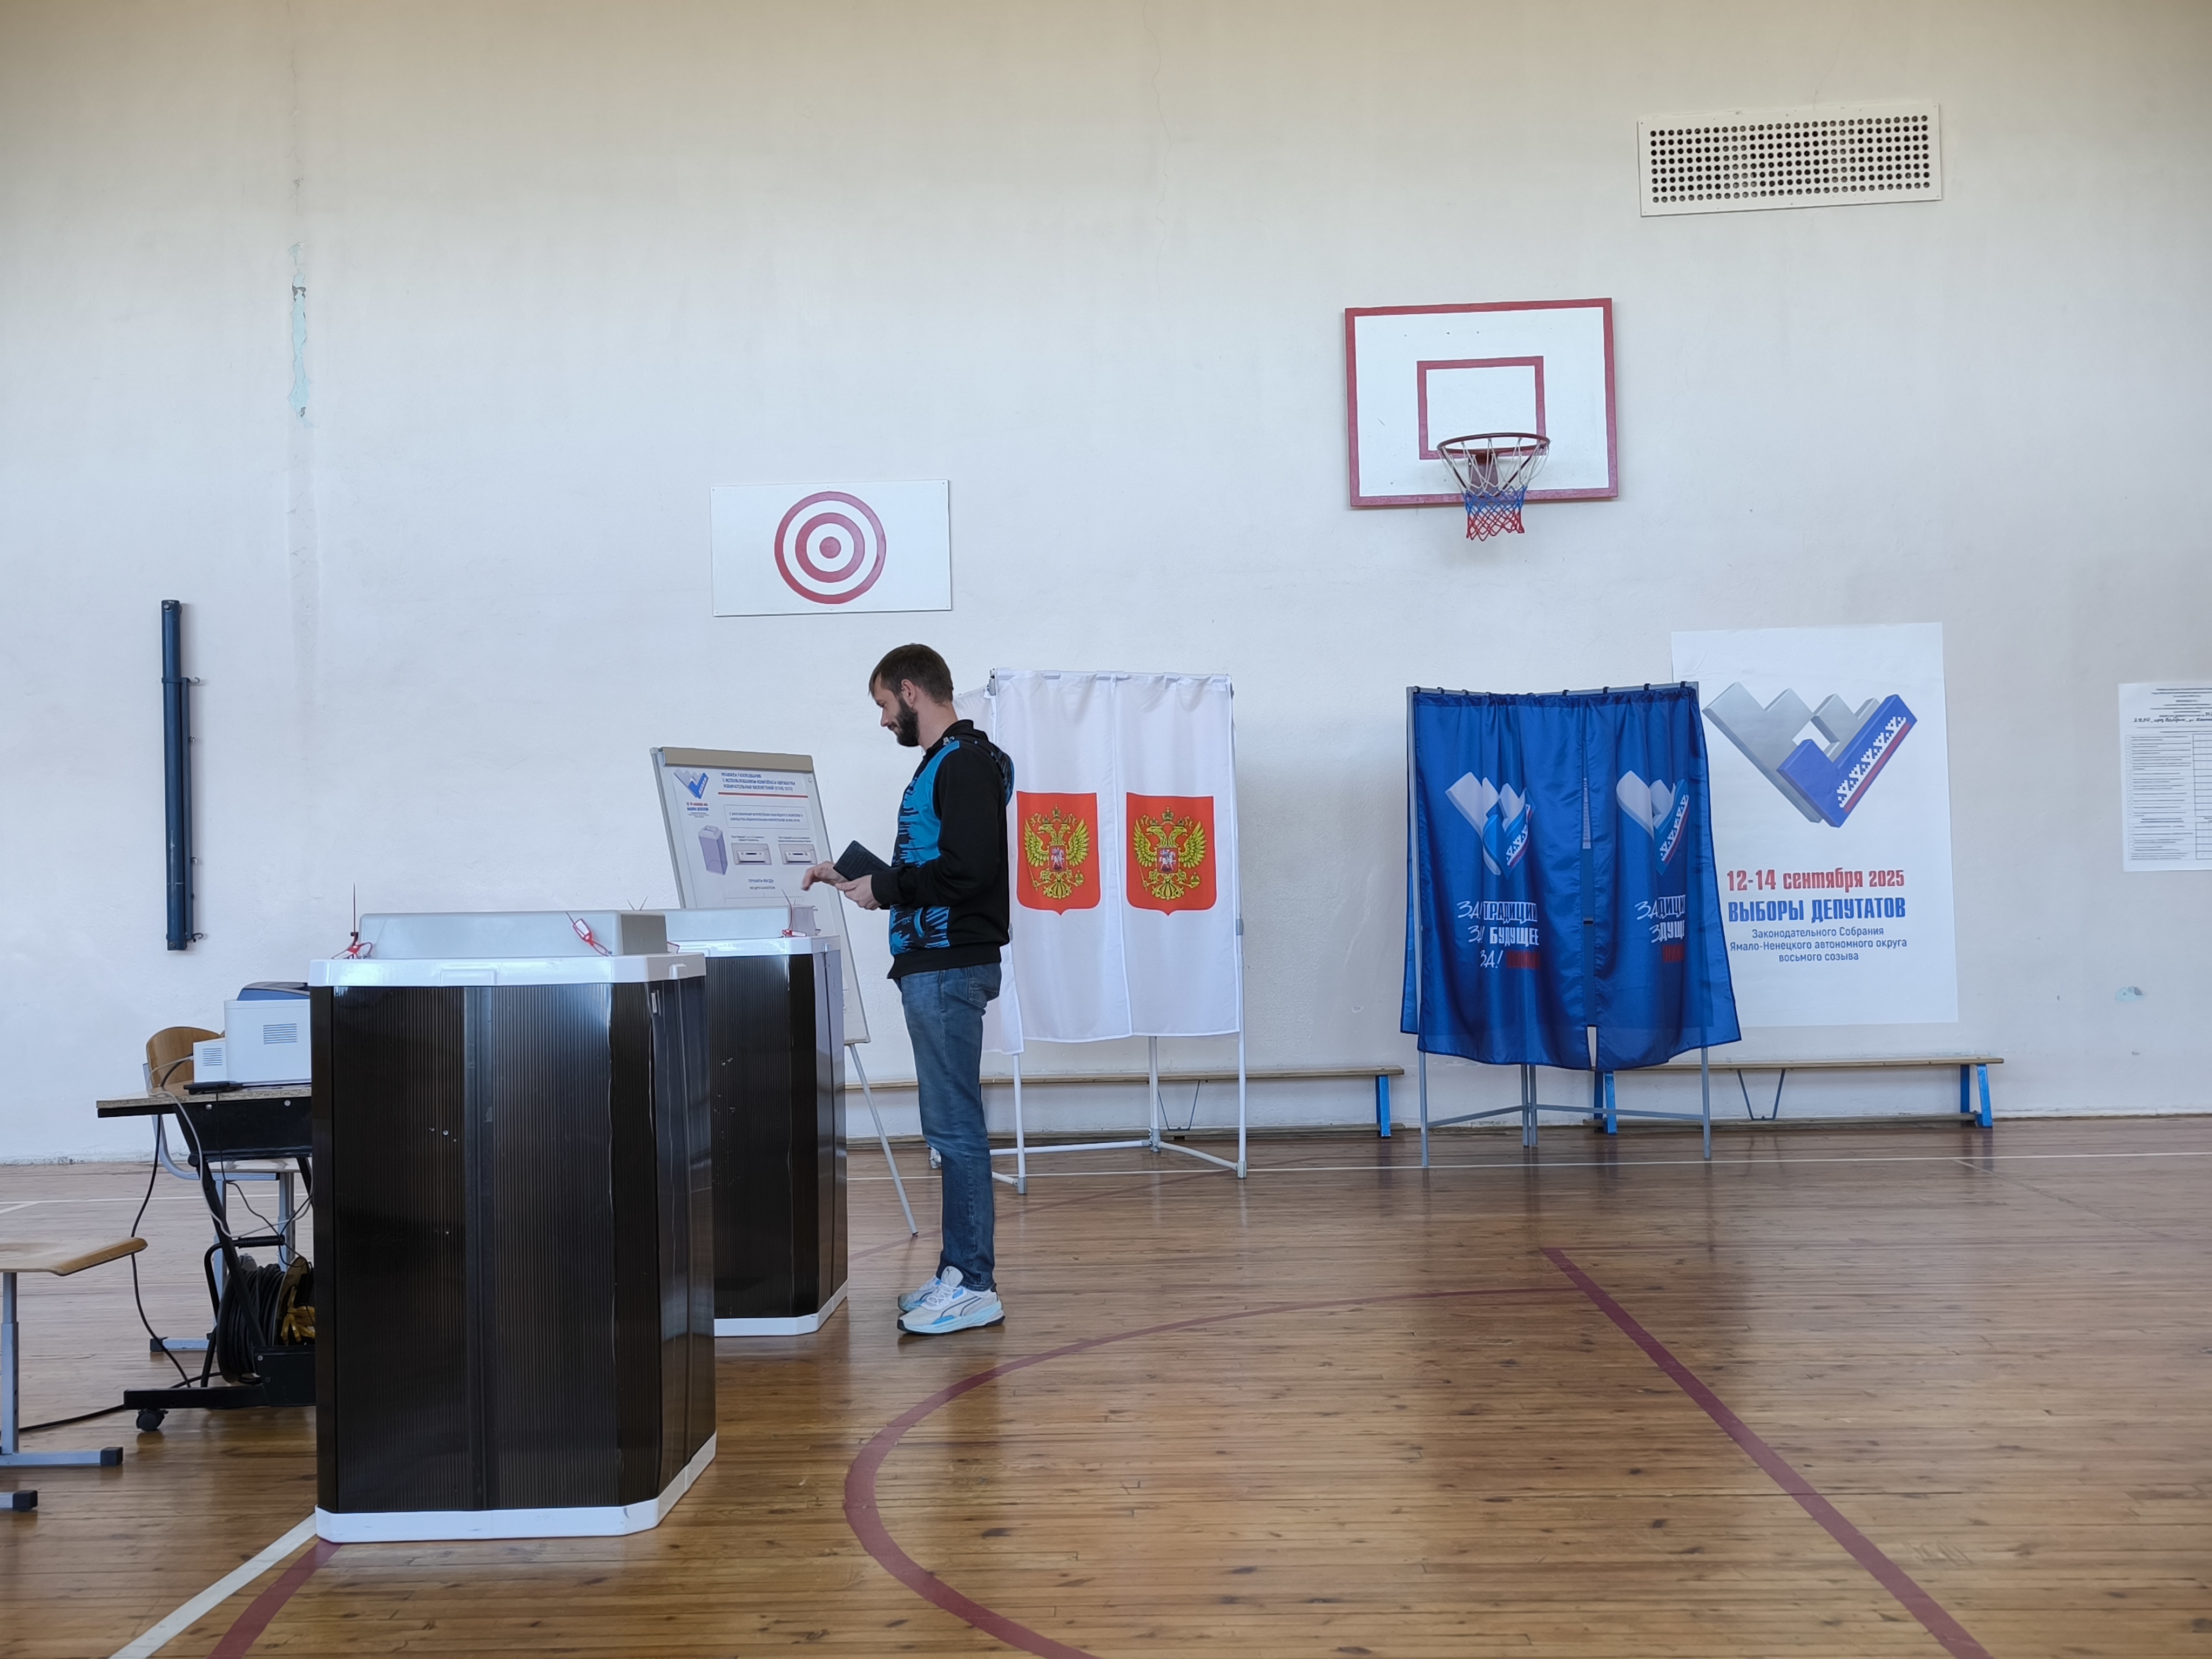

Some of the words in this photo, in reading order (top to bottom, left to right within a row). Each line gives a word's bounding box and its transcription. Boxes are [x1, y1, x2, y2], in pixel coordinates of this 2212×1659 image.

[1727, 869, 1776, 891] 12-14
[1783, 867, 1863, 893] сентября
[1869, 869, 1905, 887] 2025
[1728, 900, 1804, 922] ВЫБОРЫ
[1811, 897, 1905, 923] ДЕПУТАТОВ
[1489, 926, 1540, 947] БУДУЩЕЕ
[1752, 928, 1837, 939] Законодательного
[1839, 927, 1884, 936] Собрания
[1730, 941, 1812, 952] Ямало-Ненецкого
[1815, 940, 1873, 949] автономного
[1876, 939, 1907, 949] округа
[1480, 949, 1503, 968] ЗА!
[1779, 953, 1822, 962] восьмого
[1824, 952, 1859, 961] созыва
